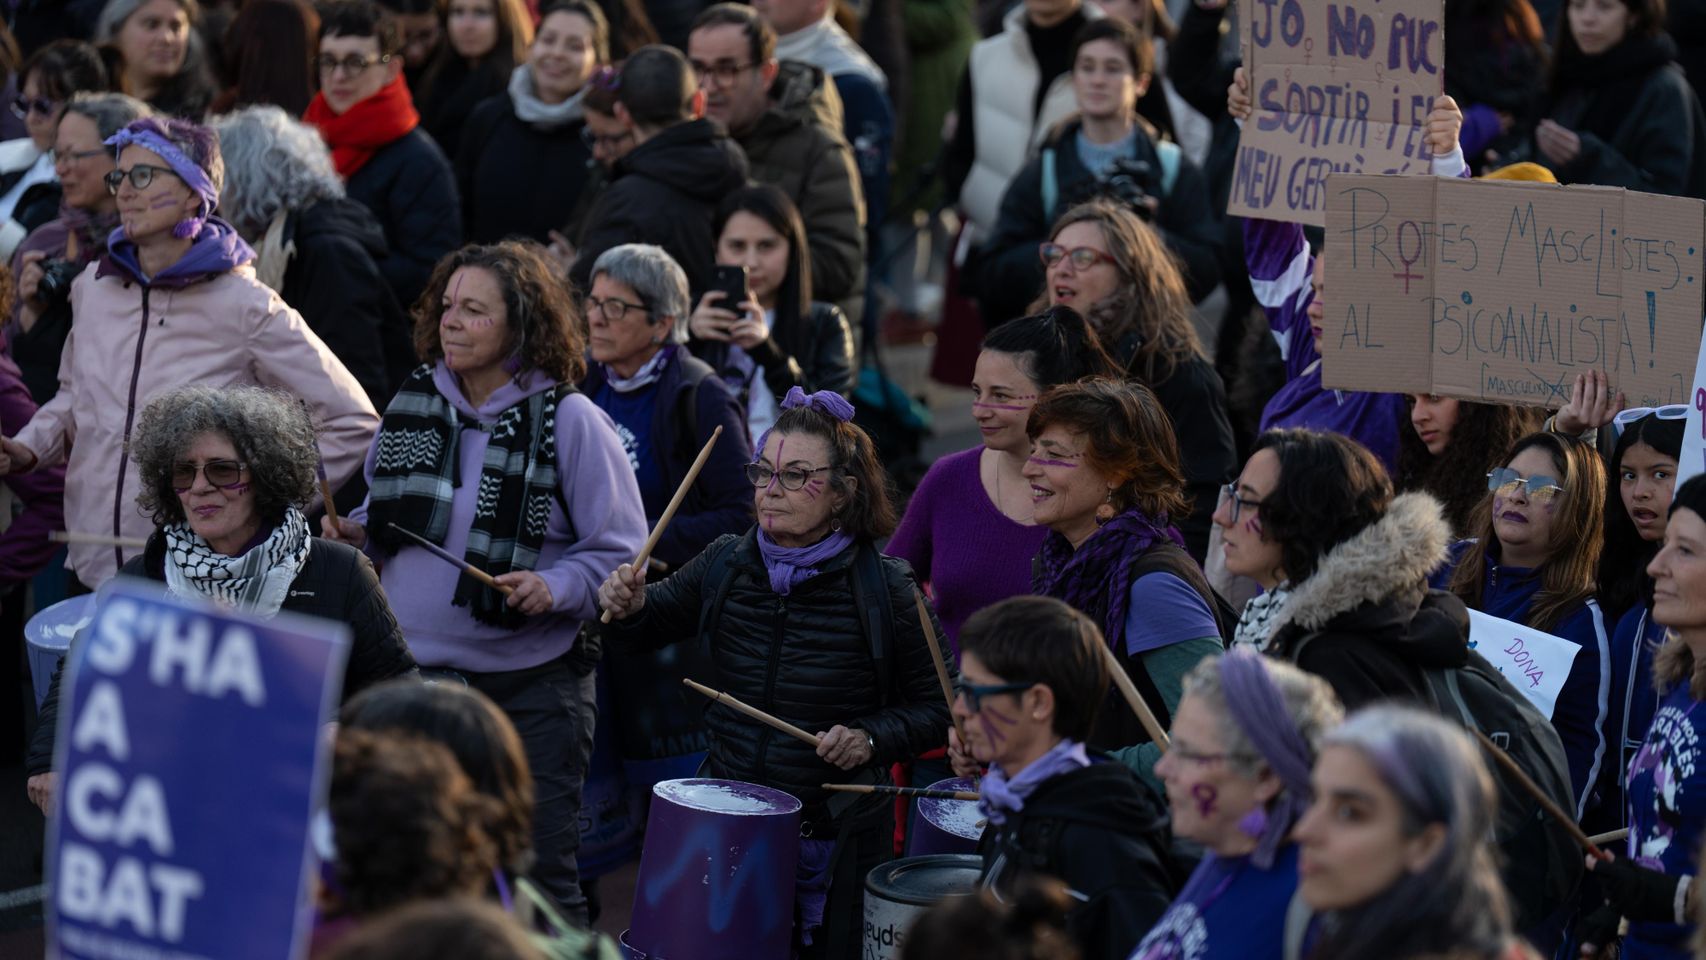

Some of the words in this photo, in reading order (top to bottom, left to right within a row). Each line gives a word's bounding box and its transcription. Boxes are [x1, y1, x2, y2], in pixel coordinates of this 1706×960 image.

[1252, 0, 1304, 48] JO
[1327, 4, 1375, 59] NO
[1388, 12, 1438, 75] PUC
[1234, 147, 1282, 209] MEU
[1287, 154, 1364, 212] GER
[1340, 303, 1384, 349] AL
[90, 599, 266, 707] S'HA
[1503, 637, 1544, 688] DONA
[73, 680, 130, 762] A
[66, 764, 174, 856] CA
[58, 842, 205, 943] BAT
